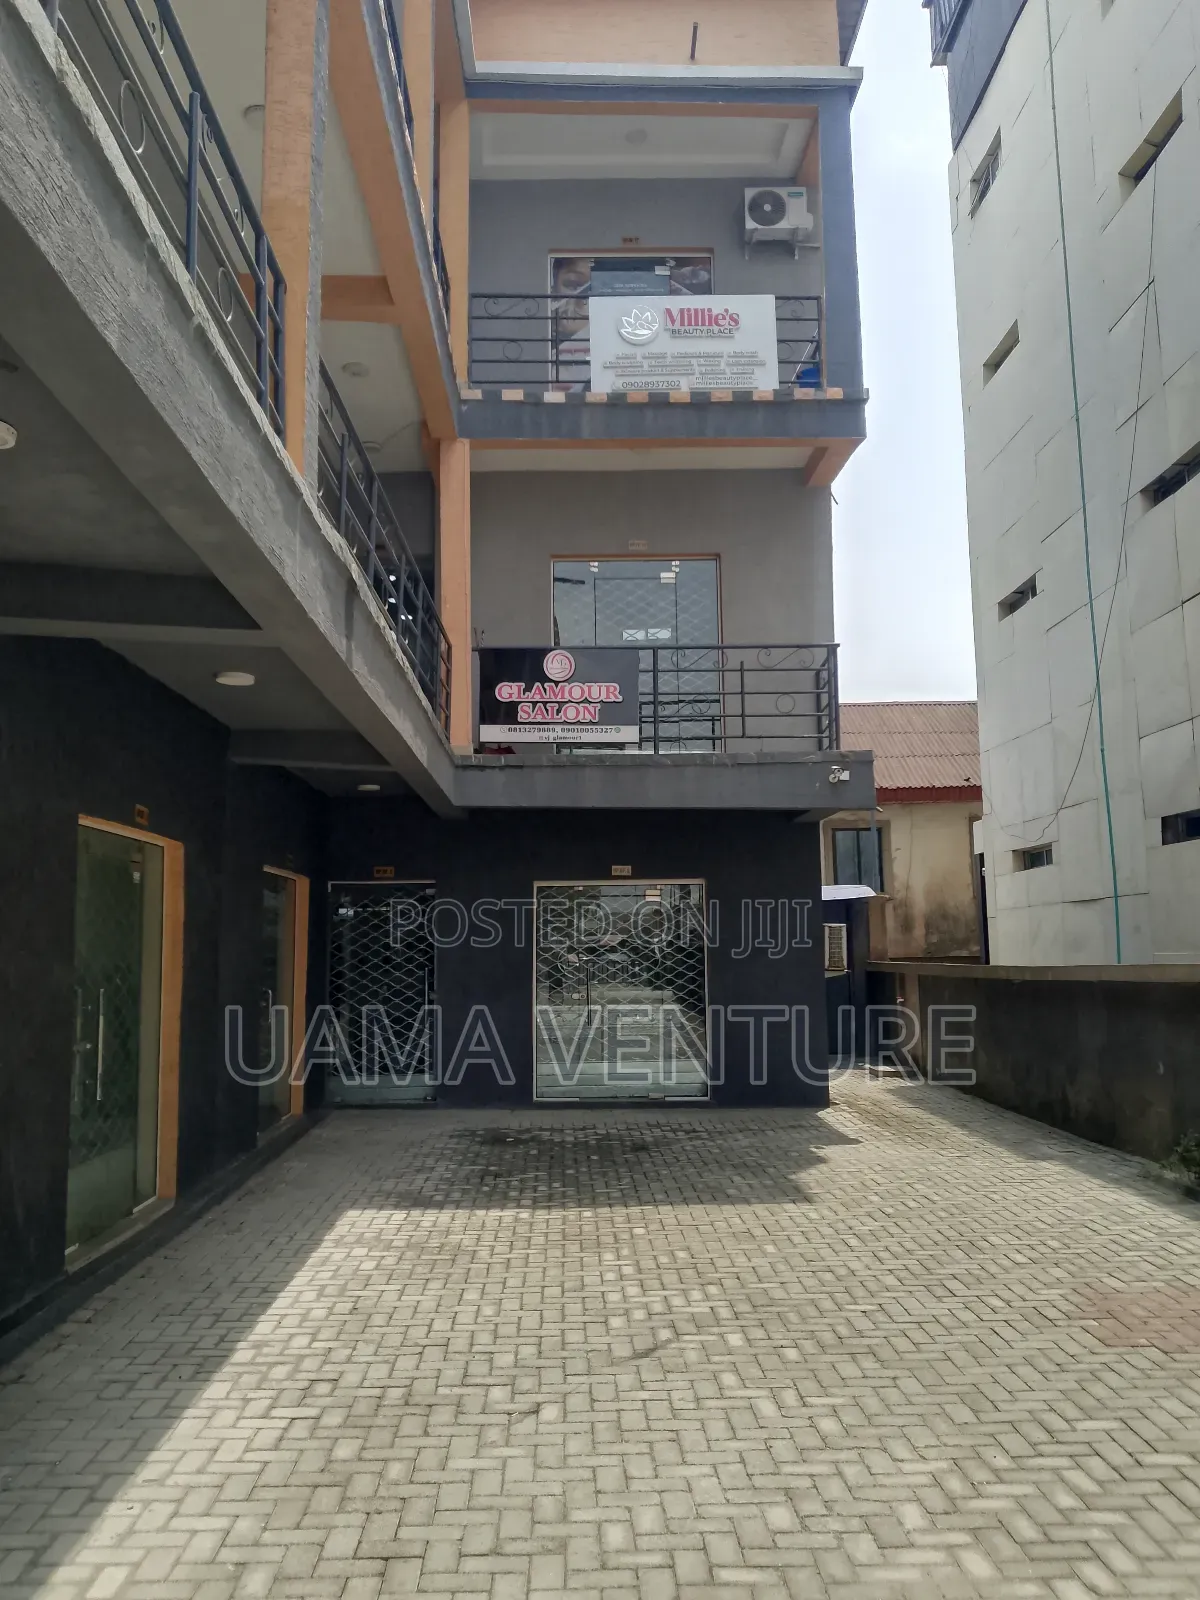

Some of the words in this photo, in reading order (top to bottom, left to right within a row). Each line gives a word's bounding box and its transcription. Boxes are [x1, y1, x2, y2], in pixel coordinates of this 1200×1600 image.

[664, 307, 740, 327] Millie's
[622, 381, 681, 389] 09028937302
[497, 684, 621, 701] GLAMOUR
[519, 703, 598, 721] SALON
